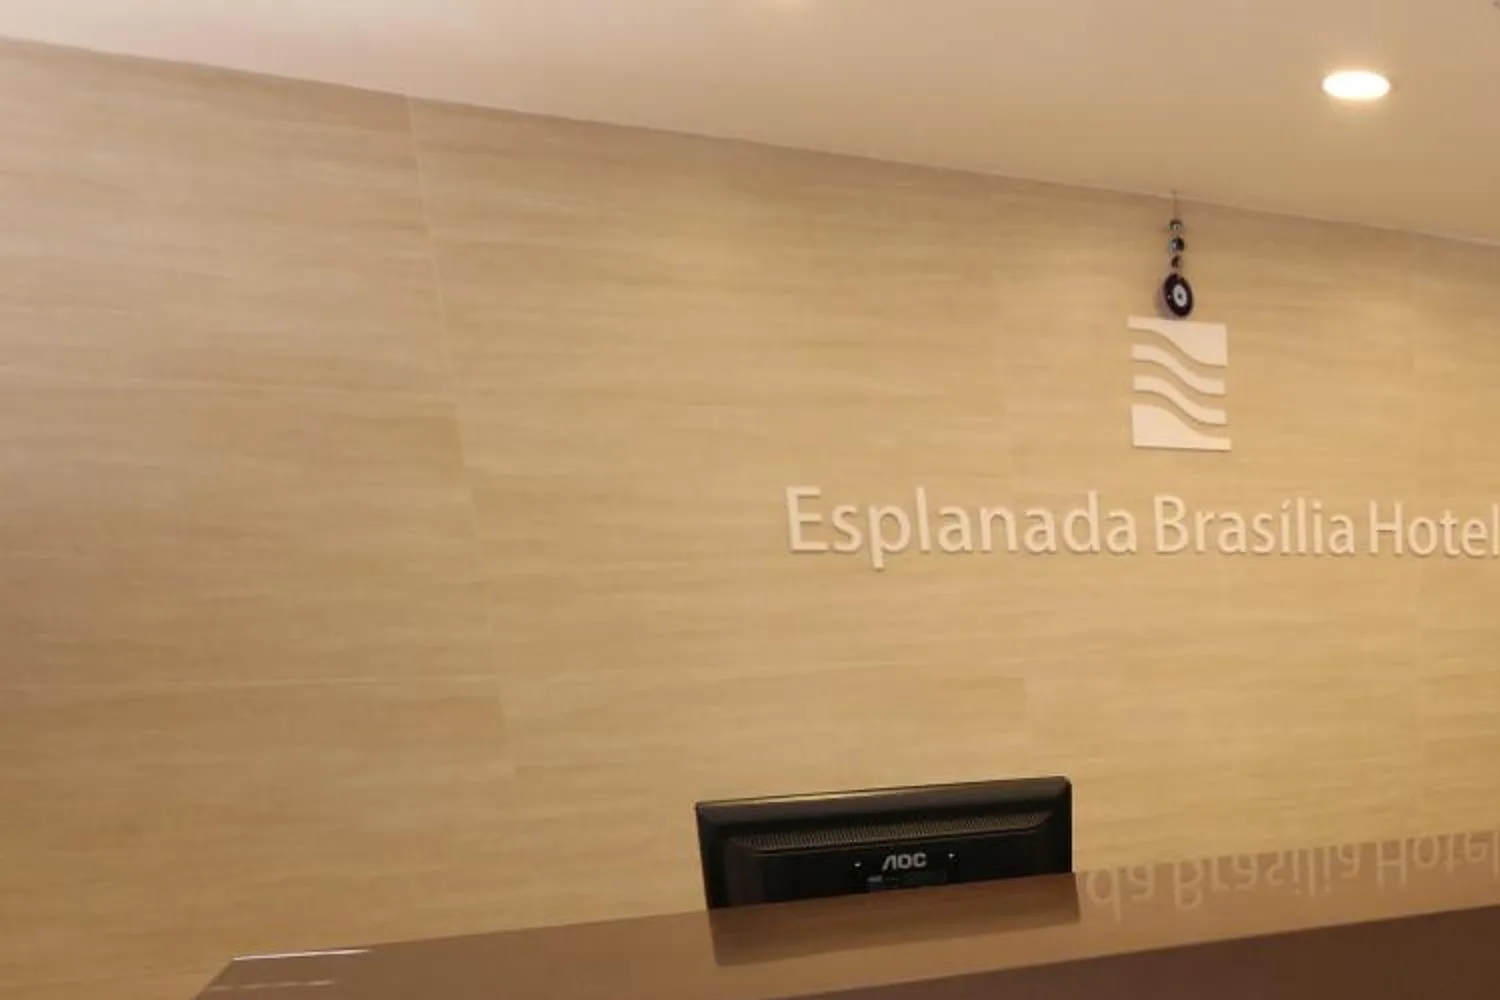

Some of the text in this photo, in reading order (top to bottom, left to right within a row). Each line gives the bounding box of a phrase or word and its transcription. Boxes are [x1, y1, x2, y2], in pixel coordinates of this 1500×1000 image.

[786, 485, 1500, 571] Esplanada Brasília Hotel
[881, 852, 927, 871] AOC
